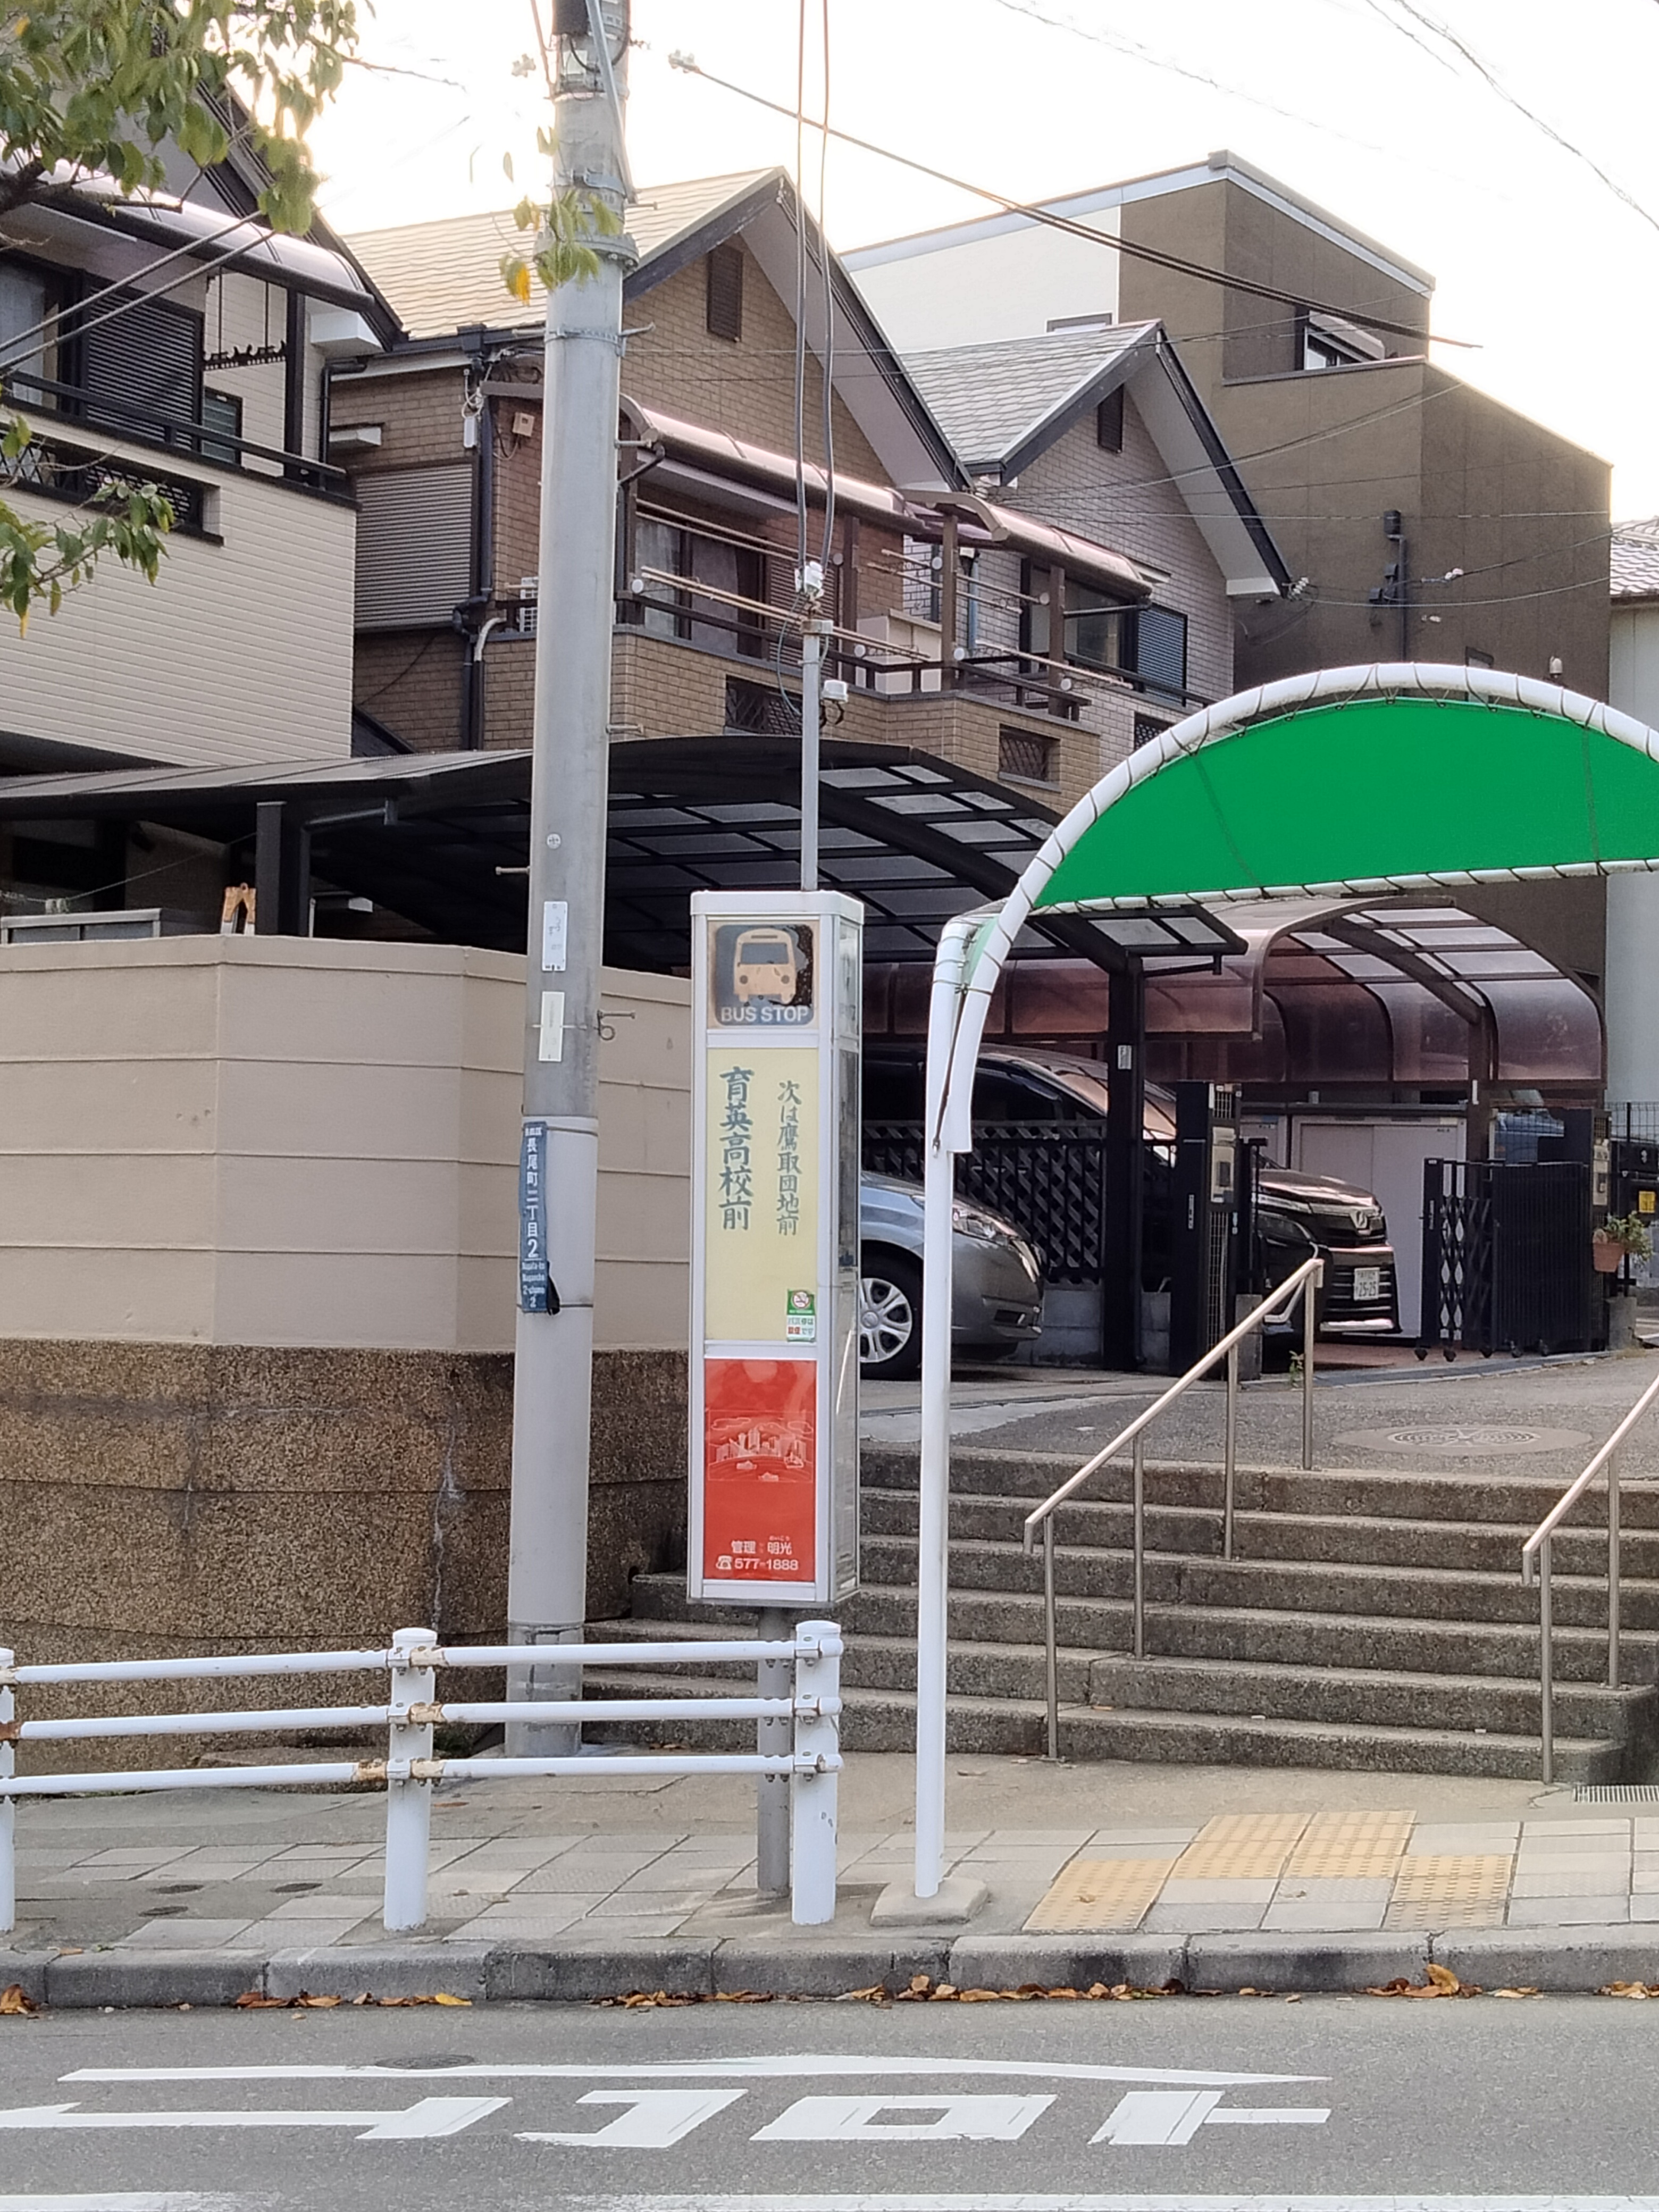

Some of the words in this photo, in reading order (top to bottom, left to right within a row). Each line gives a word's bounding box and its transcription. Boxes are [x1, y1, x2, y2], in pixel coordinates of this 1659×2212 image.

[721, 1007, 756, 1022] BUS
[761, 1007, 808, 1022] STOP
[718, 1066, 755, 1230] 育英高校前
[777, 1080, 801, 1236] 次は鷹取団地前
[735, 1558, 798, 1570] 577-1888
